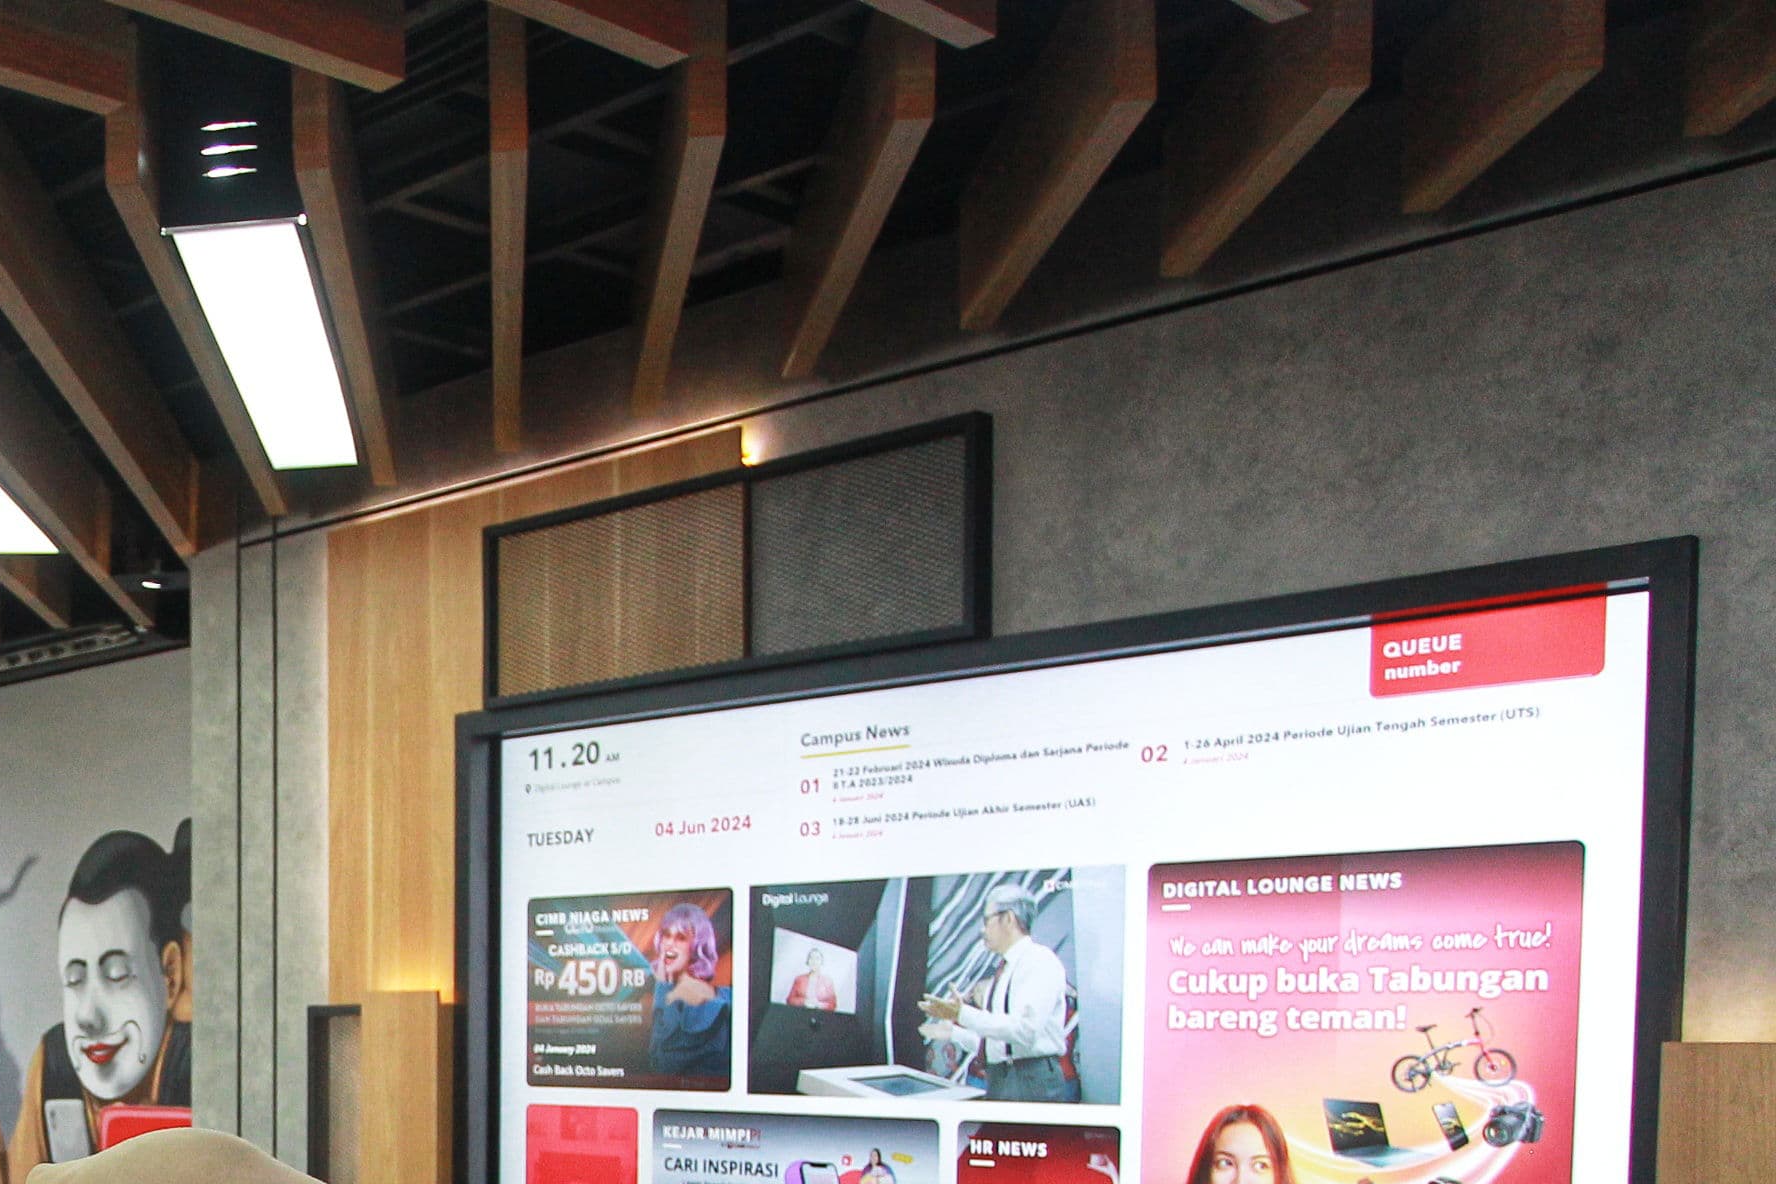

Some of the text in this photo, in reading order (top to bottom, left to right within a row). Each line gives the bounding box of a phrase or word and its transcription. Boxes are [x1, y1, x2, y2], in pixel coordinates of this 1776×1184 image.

[1383, 633, 1462, 658] QUEUE
[1384, 659, 1462, 681] number
[801, 725, 910, 747] Campus News
[1185, 706, 1540, 749] 1-26 April 2024 Periode Ujian Tengah Semester (UTS)
[529, 740, 601, 771] 11.20
[905, 760, 931, 771] 2024
[1086, 741, 1130, 752] Periode
[1141, 745, 1168, 763] 02
[800, 778, 820, 794] 01
[862, 814, 882, 824] Juni
[885, 812, 909, 823] 2024
[912, 809, 950, 820] Periode
[982, 804, 1009, 815] Akhir
[1013, 802, 1062, 813] Semester
[655, 815, 752, 837] 04 Jun 2024
[800, 820, 821, 836] 03
[527, 828, 595, 848] TUESDAY
[1162, 871, 1402, 899] DIGITAL LOUNGE NEWS
[535, 908, 649, 926] CIMB NIAGA NEWS
[548, 942, 609, 957] CASHBACK
[1169, 921, 1552, 963] We can make your dreams come true!
[534, 959, 645, 996] Rp 450 RB
[1168, 966, 1549, 1001] Cukup buka Tabungan
[1167, 1003, 1408, 1038] bareng teman!
[533, 1064, 625, 1077] Cash Back Octo Savers
[662, 1125, 752, 1142] KEJAR MIMPI
[969, 1138, 1047, 1158] HR NEWS
[664, 1157, 778, 1178] CARI INSPIRASI
